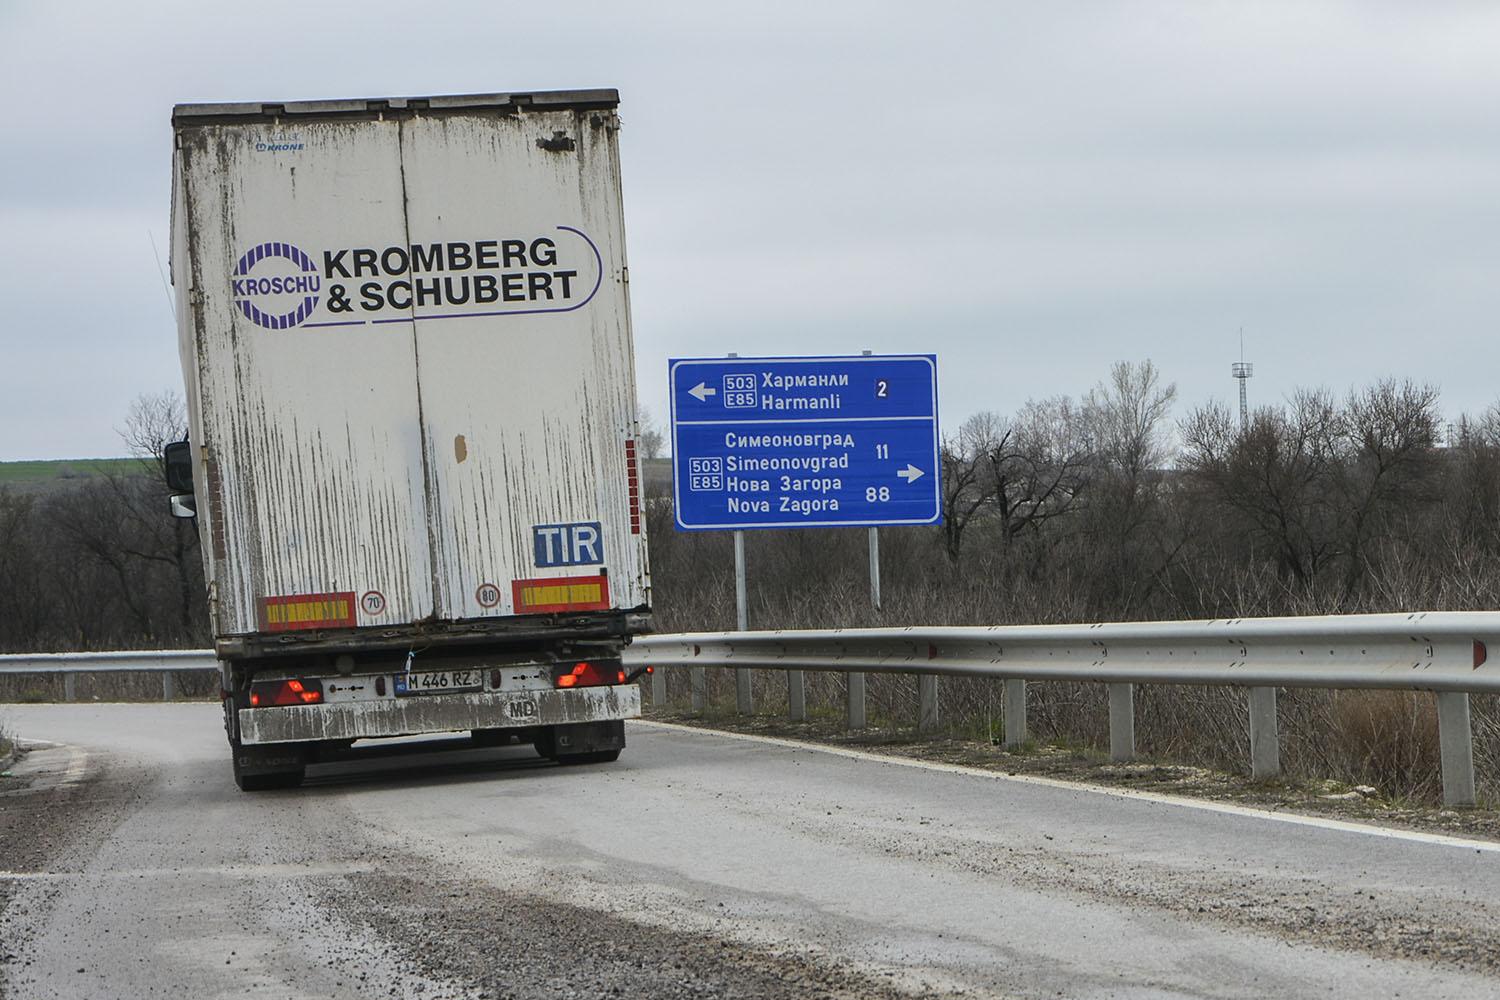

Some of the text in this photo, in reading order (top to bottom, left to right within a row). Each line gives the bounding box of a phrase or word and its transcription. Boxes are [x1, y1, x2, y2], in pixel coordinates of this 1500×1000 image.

[324, 237, 557, 278] KROMBERG
[233, 275, 320, 297] KROSCHU
[327, 271, 577, 313] & SCHUBERT
[727, 377, 754, 389] 503
[762, 372, 848, 390] Харманли
[878, 381, 887, 397] 2
[727, 394, 754, 406] E85
[762, 394, 840, 410] Harmanli
[725, 431, 855, 449] Симеоновград
[875, 444, 888, 459] 11
[693, 460, 720, 472] 503
[727, 453, 849, 472] Simeonovgrad
[693, 476, 721, 488] E85
[727, 475, 842, 492] Нова Загора
[866, 487, 890, 502] 88
[728, 497, 839, 516] Nova Zagora
[537, 526, 599, 564] TIR
[368, 597, 380, 609] 70
[482, 590, 495, 602] 80
[409, 672, 472, 689] M 446 RZ
[511, 702, 533, 717] MD
